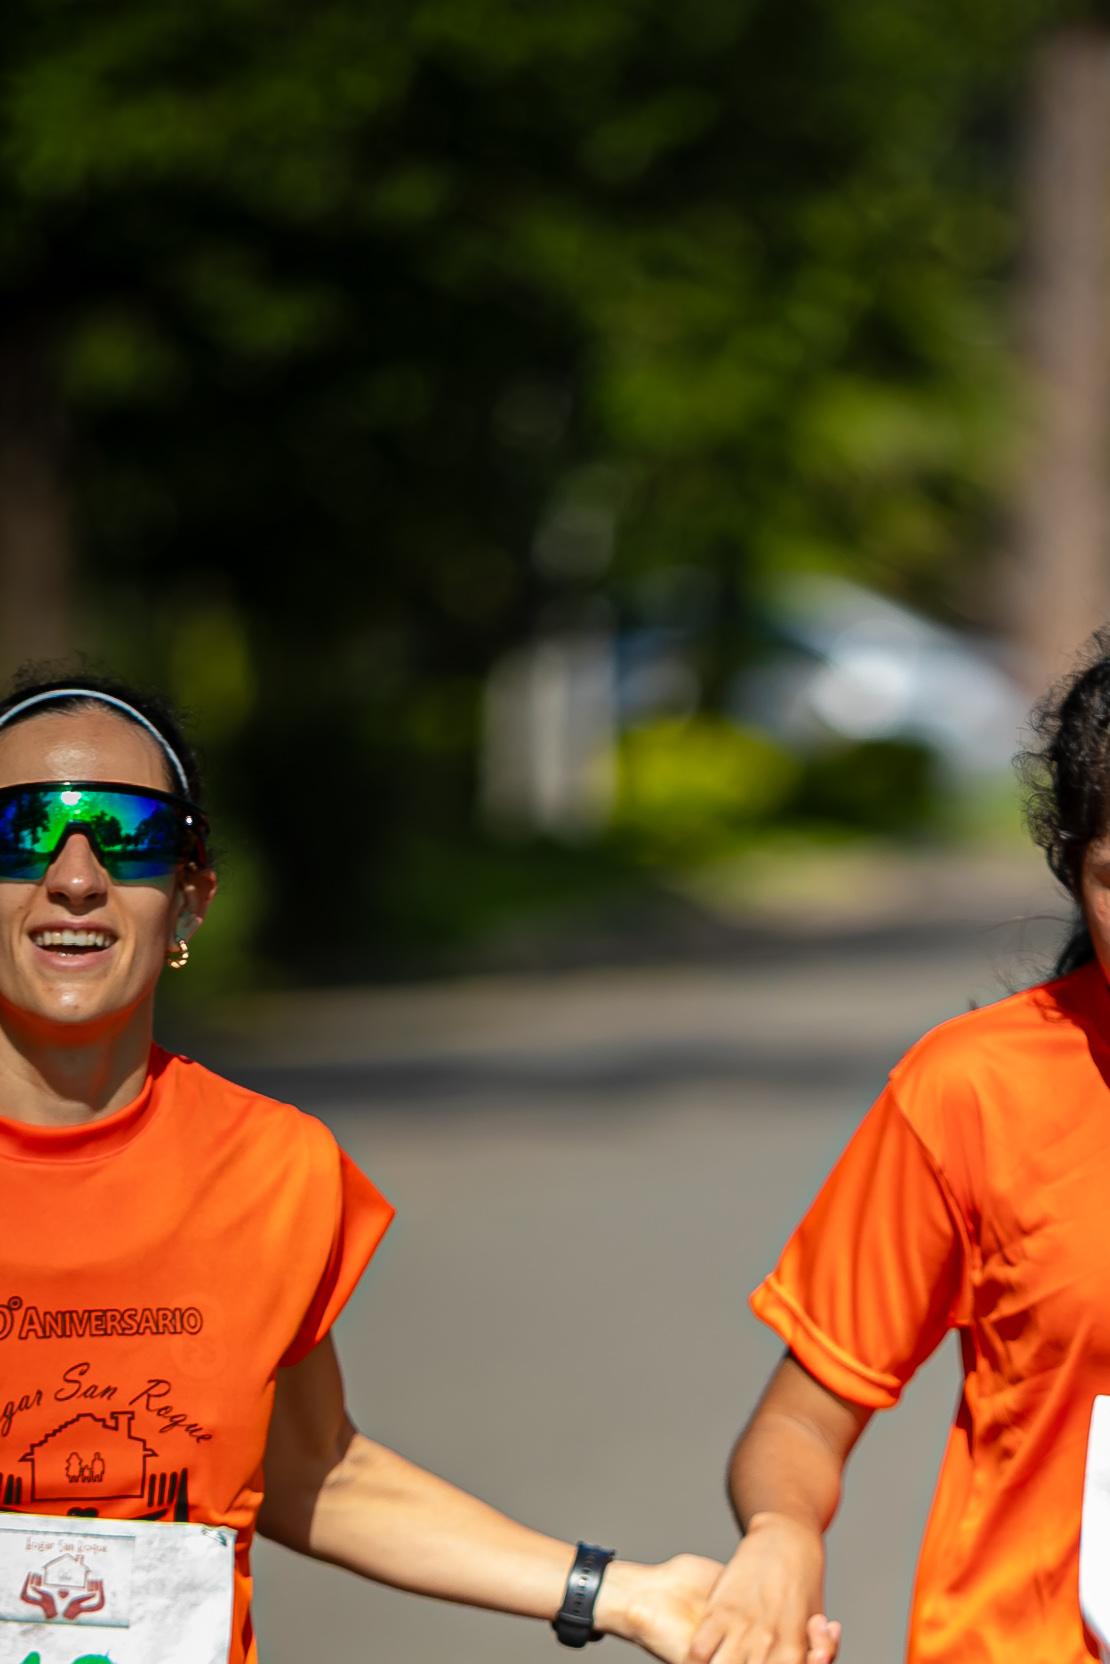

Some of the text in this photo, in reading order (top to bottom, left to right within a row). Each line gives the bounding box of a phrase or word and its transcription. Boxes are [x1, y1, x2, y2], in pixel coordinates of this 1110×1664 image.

[18, 1306, 204, 1340] ANIVERSARIO
[54, 1362, 118, 1402] San
[129, 1379, 213, 1443] Roque
